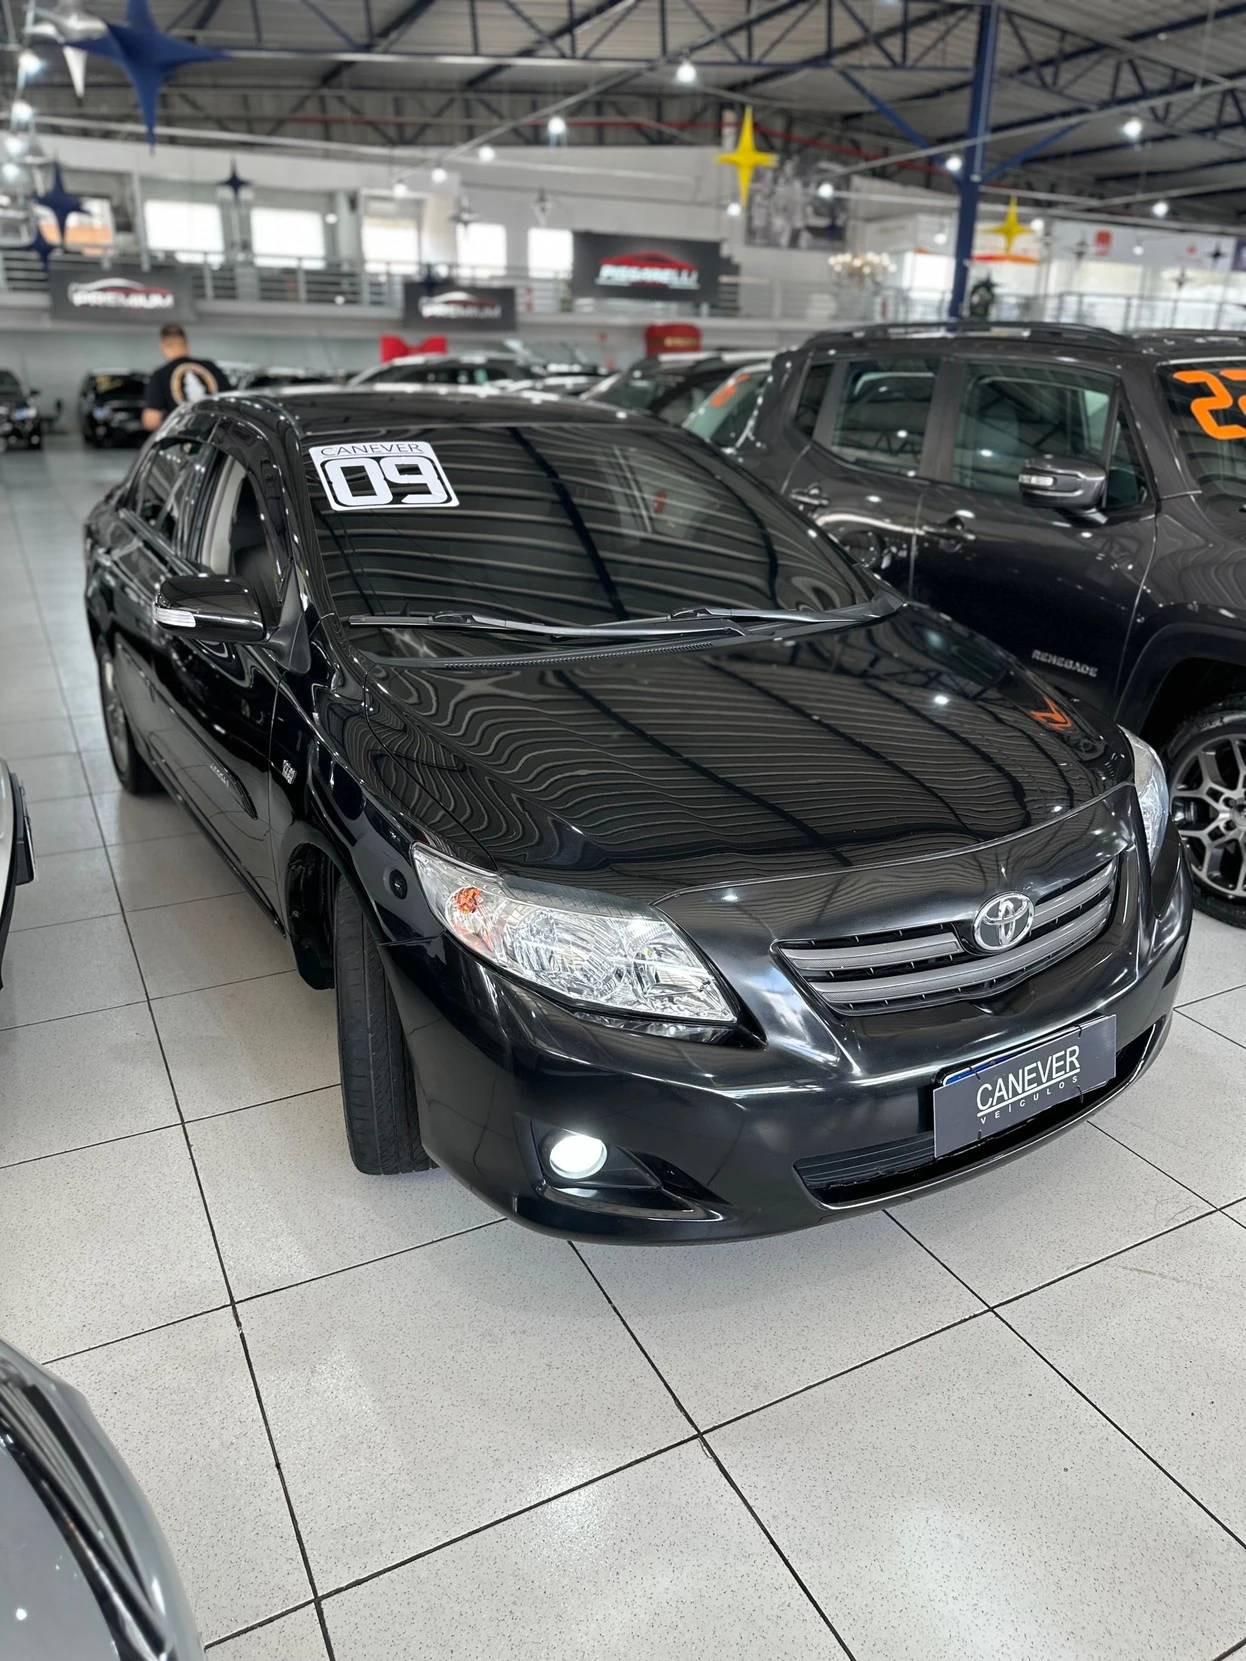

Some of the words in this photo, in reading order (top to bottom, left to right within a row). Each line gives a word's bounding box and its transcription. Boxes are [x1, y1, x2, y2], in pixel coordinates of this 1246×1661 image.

[320, 443, 425, 457] CANEVER
[323, 455, 449, 506] 09
[1031, 649, 1099, 677] RENEGADE
[976, 1045, 1081, 1111] CANEVER
[980, 1075, 1078, 1125] VEICULOS
